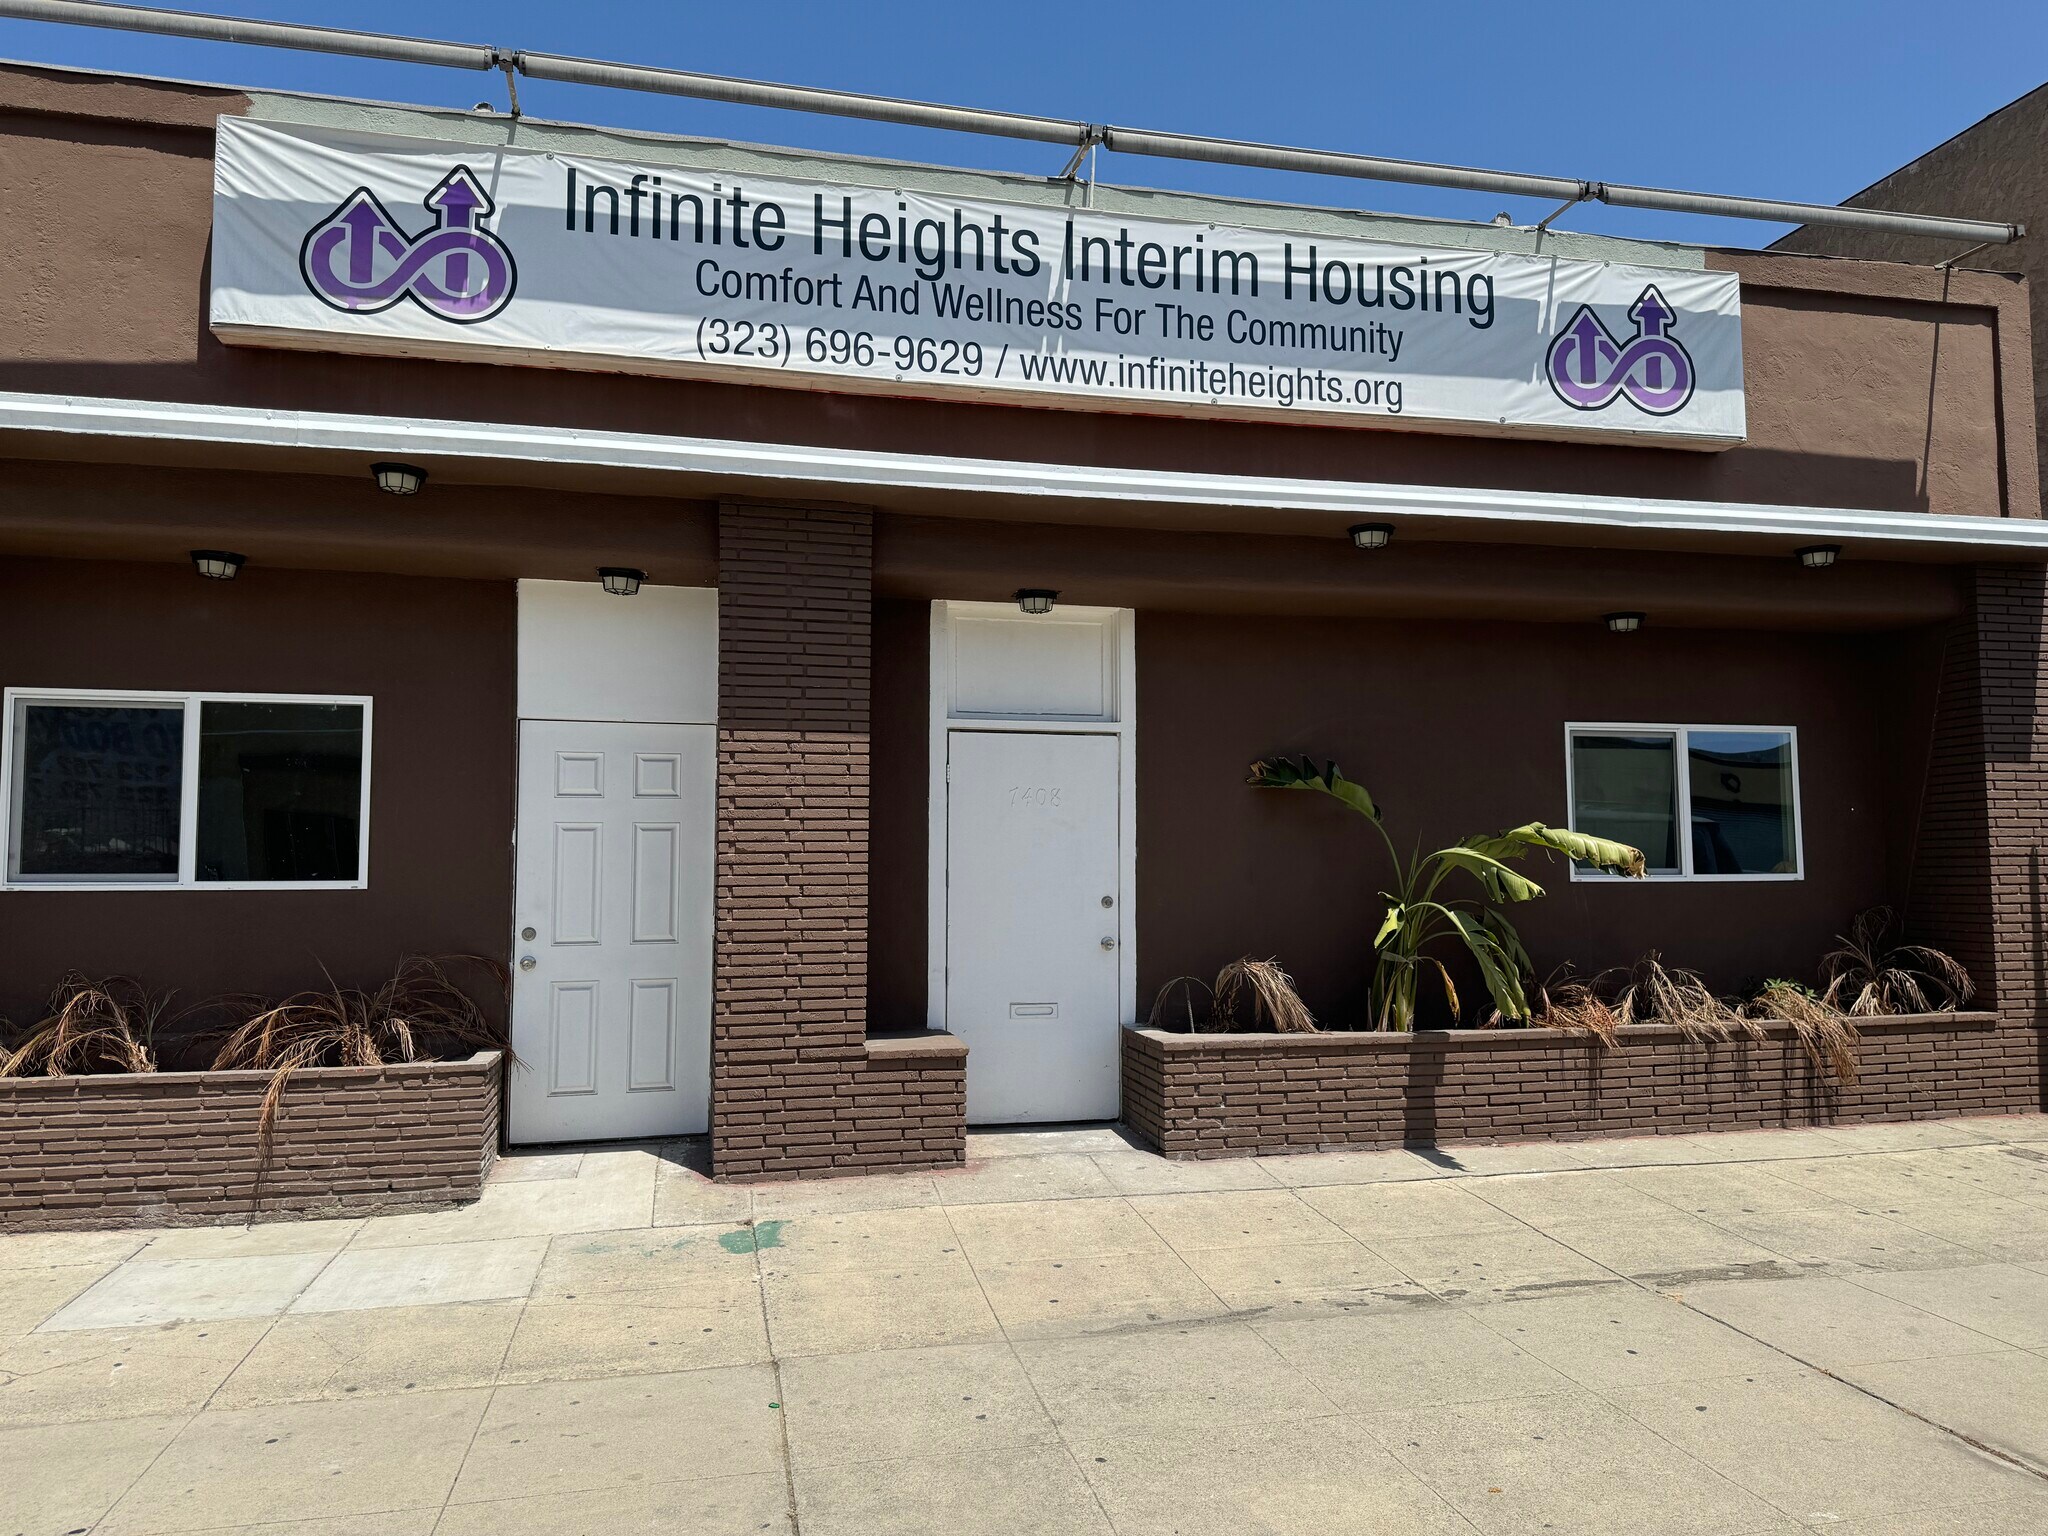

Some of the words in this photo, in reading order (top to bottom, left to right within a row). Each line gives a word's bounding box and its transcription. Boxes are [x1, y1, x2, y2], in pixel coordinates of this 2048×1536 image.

[566, 167, 786, 252] Infinite
[813, 193, 1041, 282] Heights
[1065, 220, 1259, 298] Interim
[1284, 242, 1495, 330] Housing
[695, 258, 843, 309] Comfort
[851, 274, 919, 316] And
[930, 281, 1083, 331] Wellness
[1095, 297, 1147, 336] For
[1154, 302, 1214, 342] The
[1227, 309, 1404, 363] Community
[696, 316, 791, 368] (323)
[806, 326, 983, 376] 696-9629
[1019, 353, 1402, 414] www.infiniteheights.org
[1008, 786, 1062, 808] 7408
